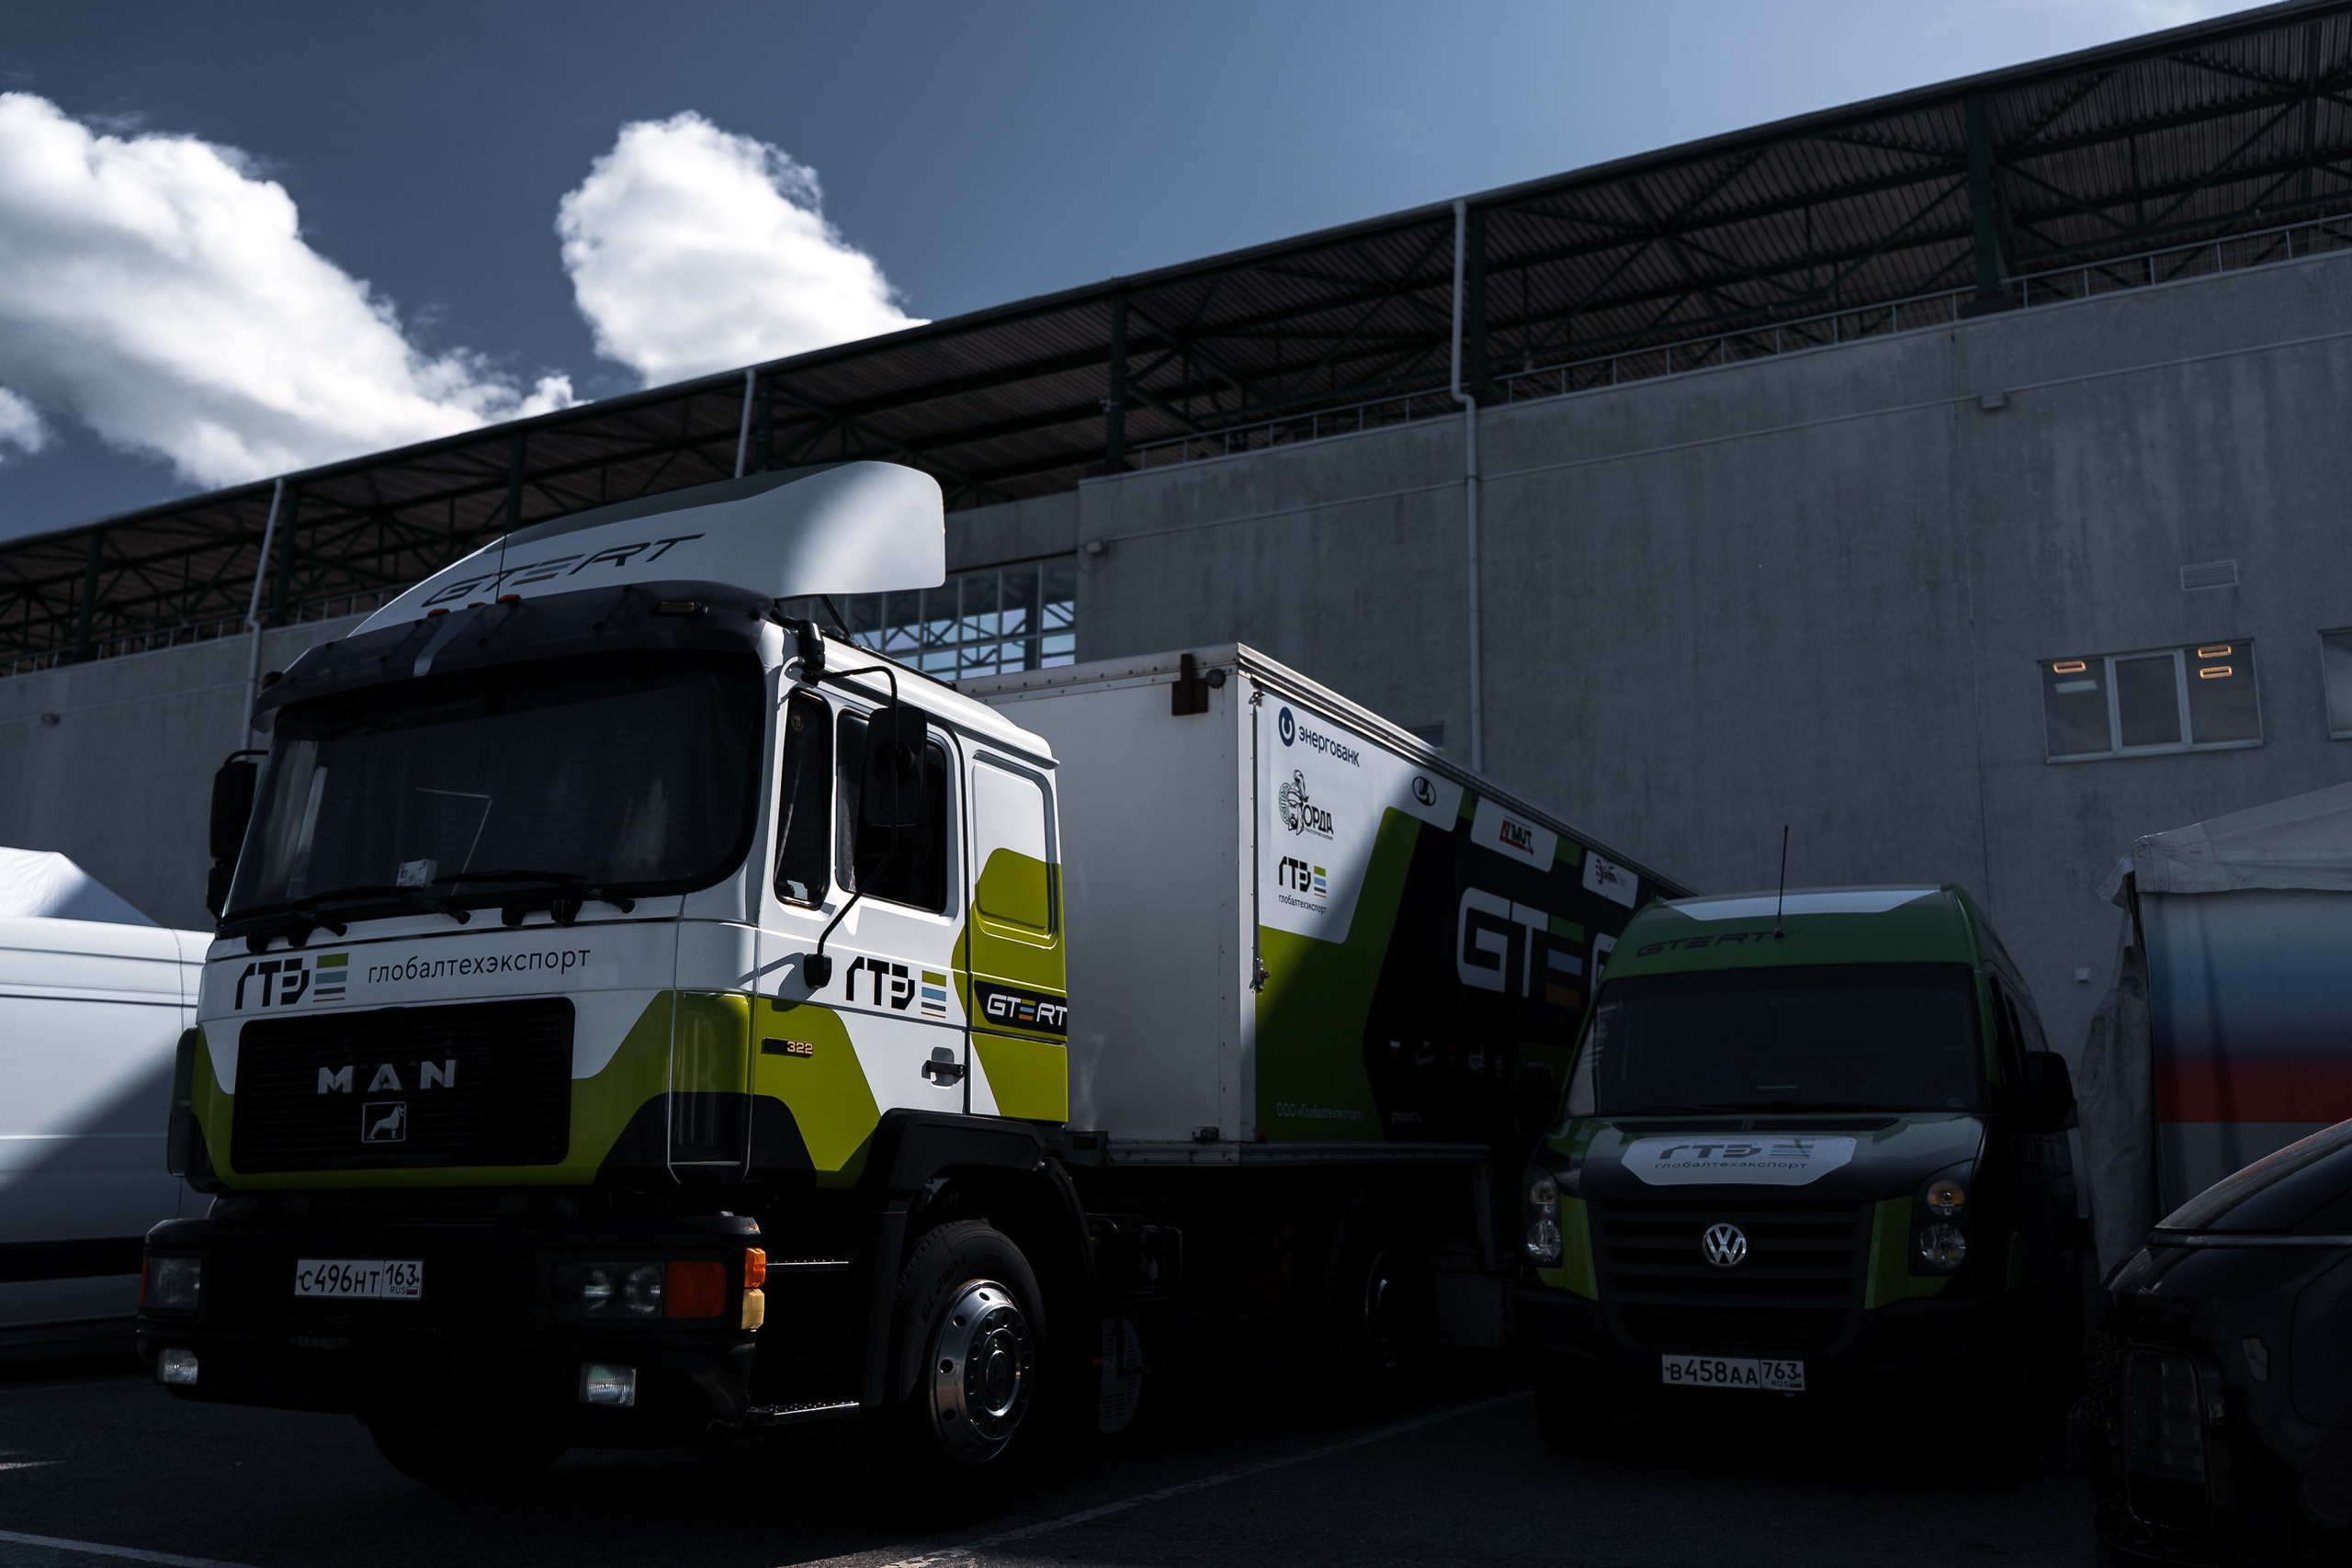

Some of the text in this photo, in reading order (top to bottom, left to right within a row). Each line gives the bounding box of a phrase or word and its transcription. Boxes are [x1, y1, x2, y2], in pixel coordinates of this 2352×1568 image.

[1298, 726, 1360, 767] энергобанк
[1303, 804, 1334, 835] ОРДА
[1279, 894, 1327, 915] глобалтехэкспорт
[368, 948, 591, 983] глобалтехэкспорт
[986, 992, 1068, 1026] GTERT
[786, 1041, 813, 1055] 322
[316, 1058, 458, 1095] MAN
[1276, 1102, 1296, 1118] ООО
[1655, 1160, 1808, 1170] глобалтехэкспорт
[385, 1264, 416, 1286] 163
[390, 1286, 406, 1294] RUS
[1762, 1362, 1798, 1380] 763
